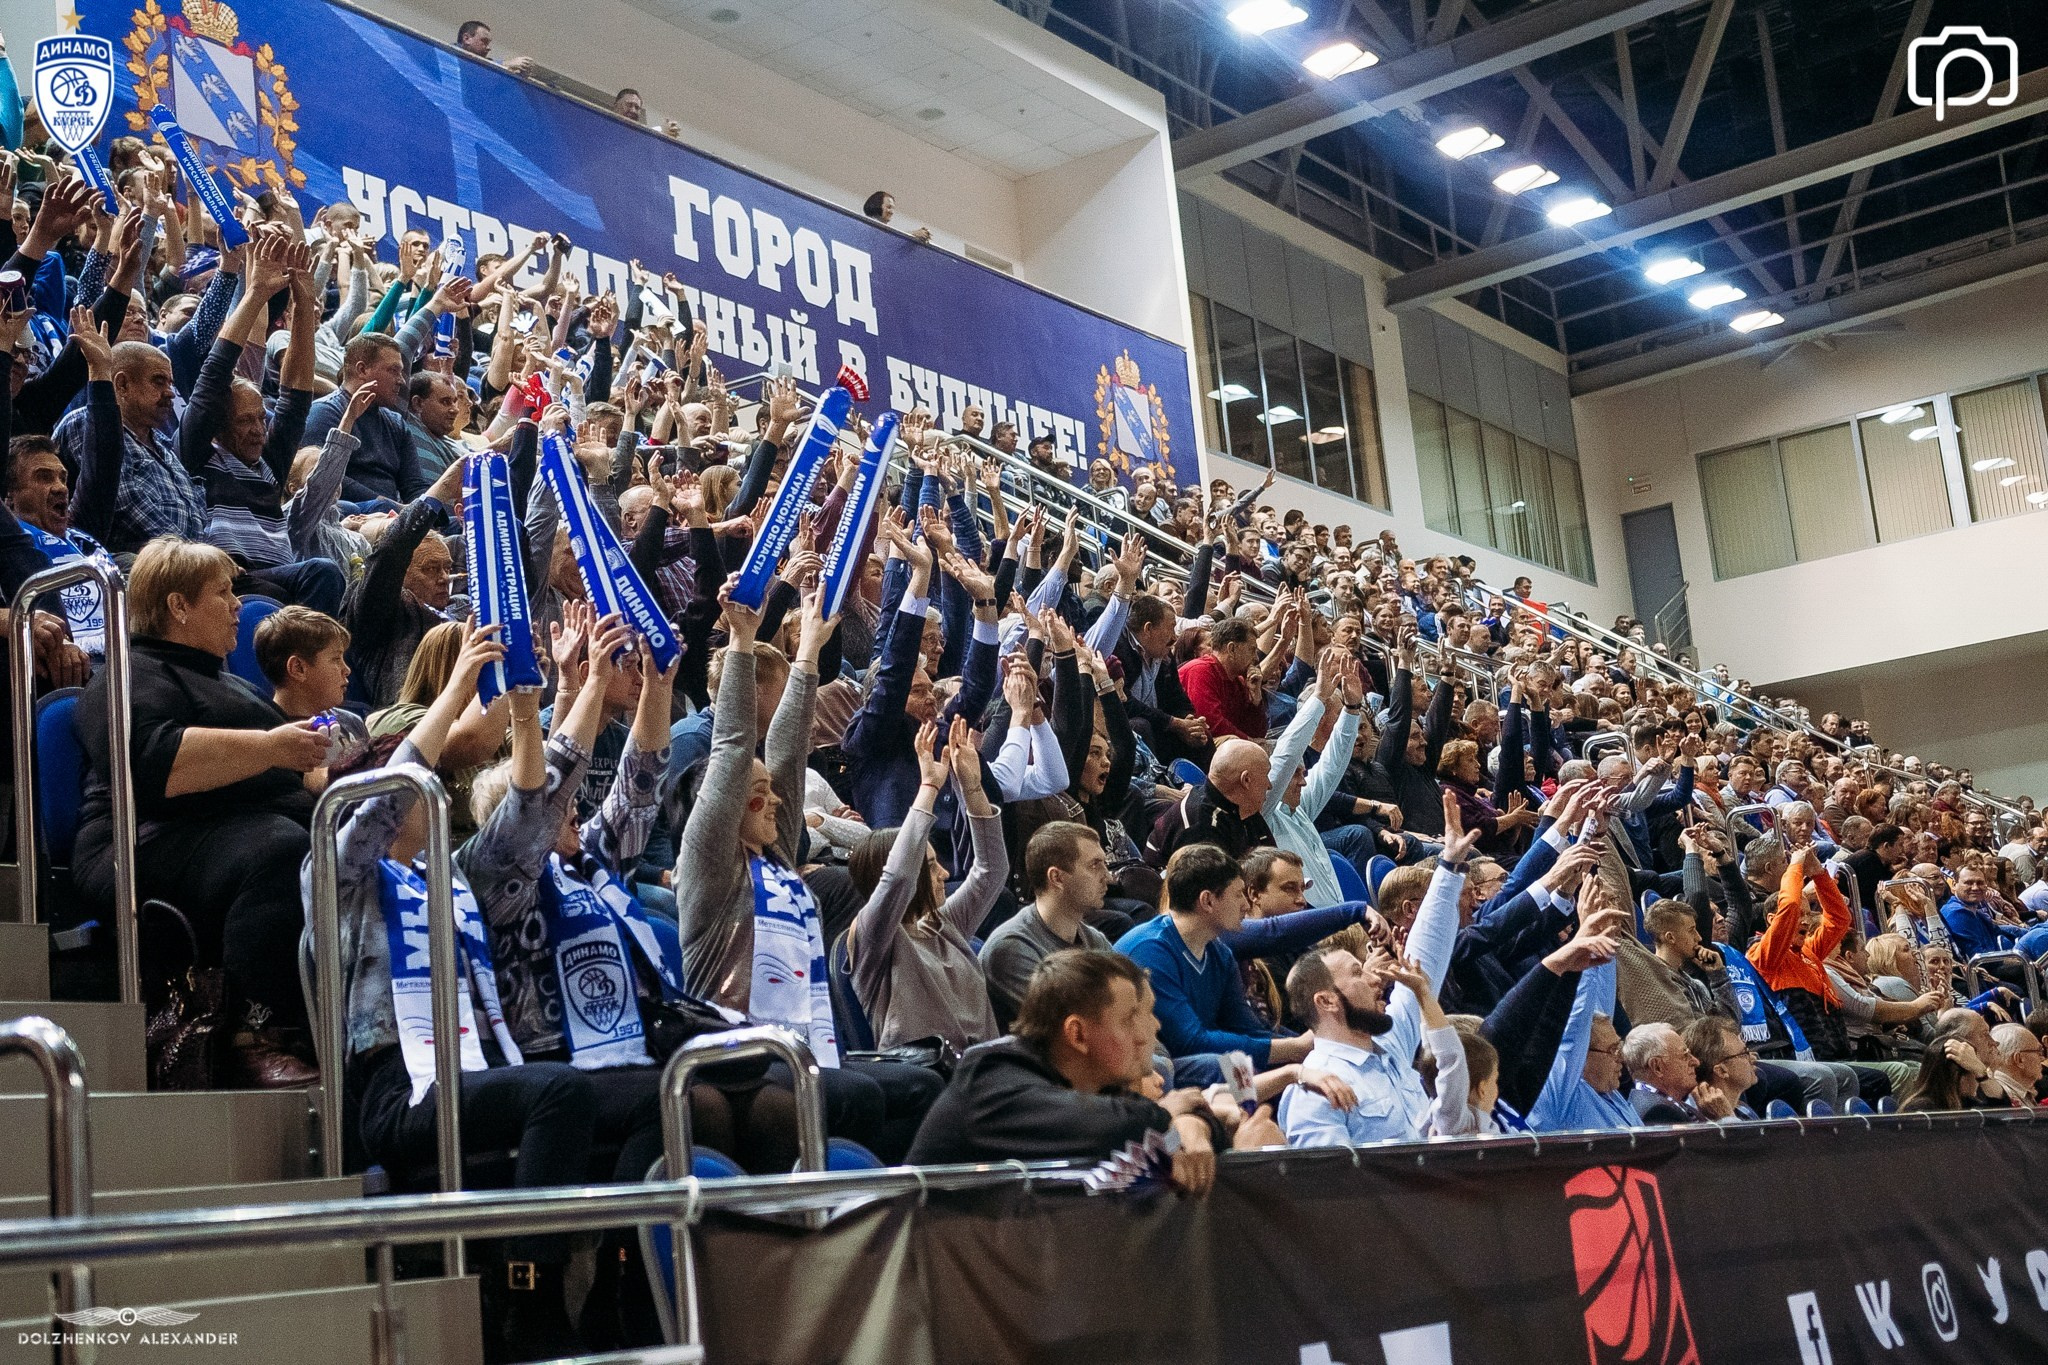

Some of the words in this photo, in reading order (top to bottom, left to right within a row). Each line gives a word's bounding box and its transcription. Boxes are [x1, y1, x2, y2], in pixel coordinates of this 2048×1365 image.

[181, 140, 225, 208] АДМИНИСТРАЦИЯ
[203, 190, 226, 223] ОБЛАСТИ
[668, 175, 878, 336] ГОРОД
[772, 456, 825, 558] АДМИНИСТРАЦИЯ
[775, 472, 806, 524] КУРСКОЙ
[826, 473, 867, 577] АДМИНИСТРАЦИЯ
[496, 510, 522, 620] АДМИНИСТРАЦИЯ
[751, 525, 780, 575] ОБЛАСТИ
[86, 618, 103, 627] 199
[615, 575, 666, 648] ДИНАМО
